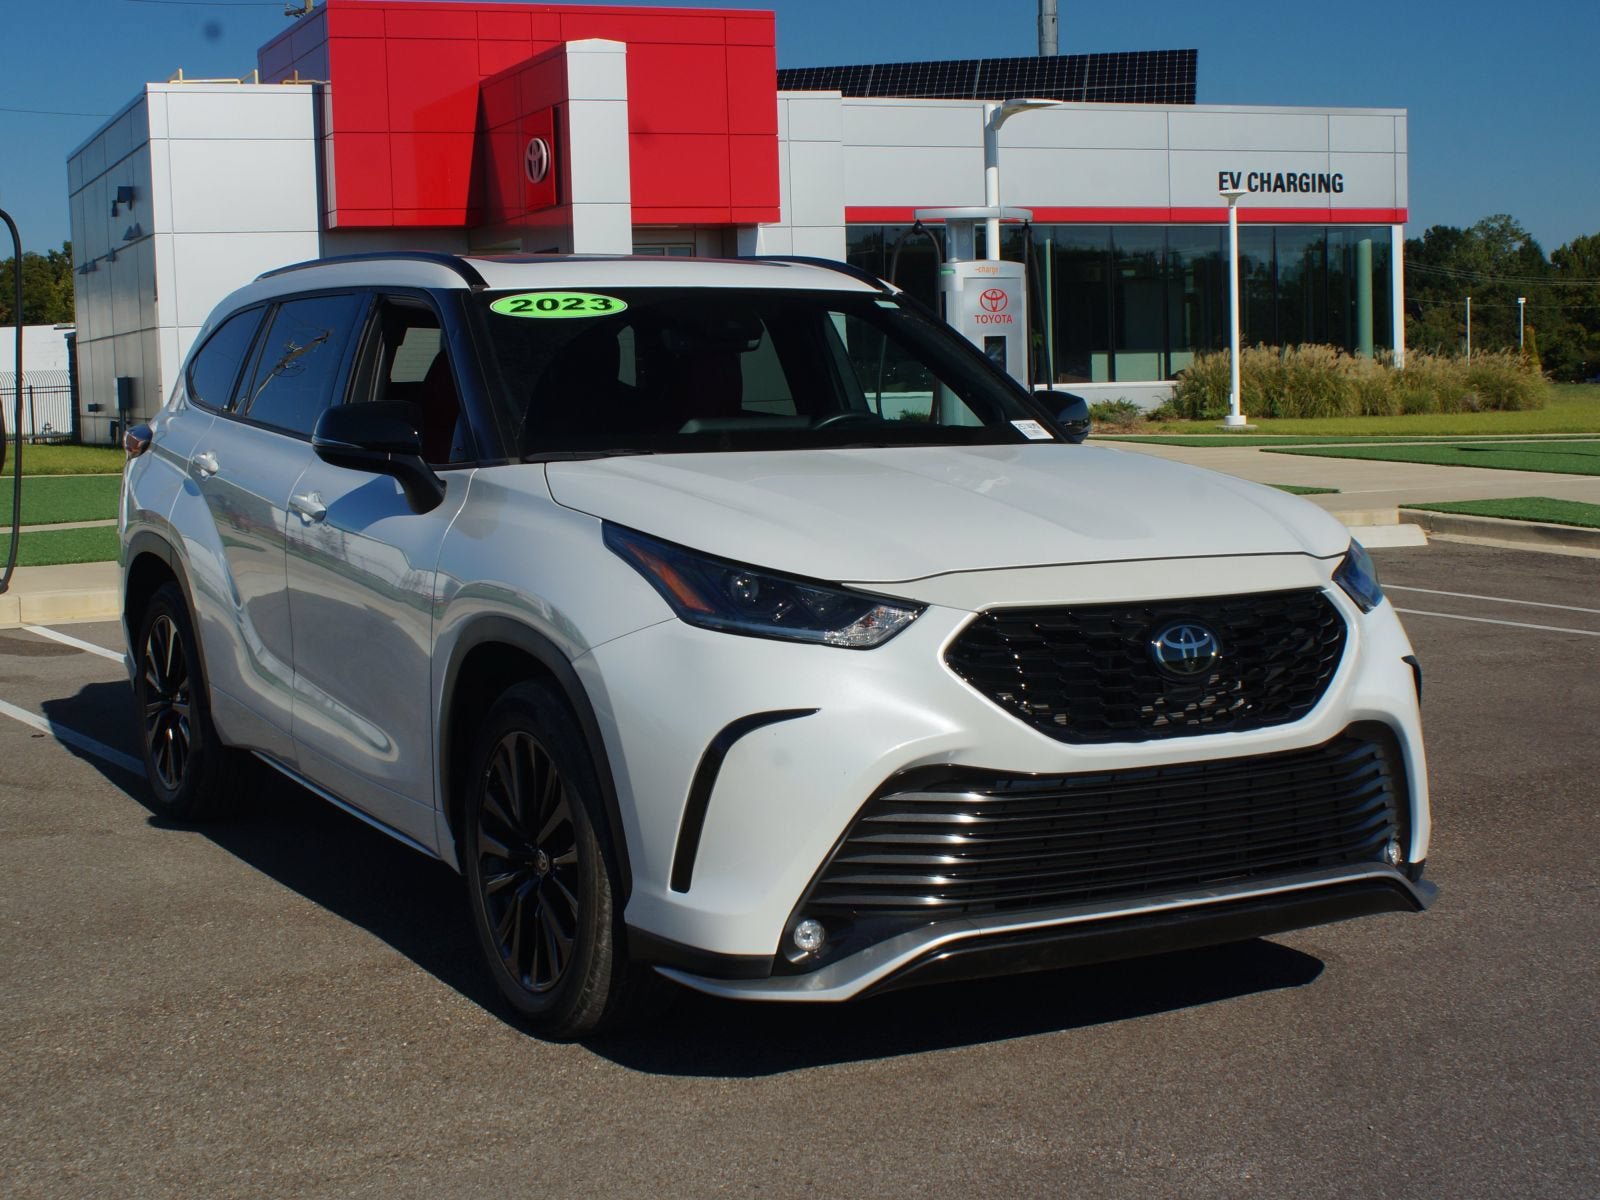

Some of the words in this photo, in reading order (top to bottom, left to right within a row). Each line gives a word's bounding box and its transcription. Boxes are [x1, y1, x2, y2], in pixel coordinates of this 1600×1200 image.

[1218, 171, 1242, 191] EV
[1247, 171, 1344, 193] CHARGING
[509, 297, 613, 313] 2023
[974, 314, 1013, 324] TOYOTA
